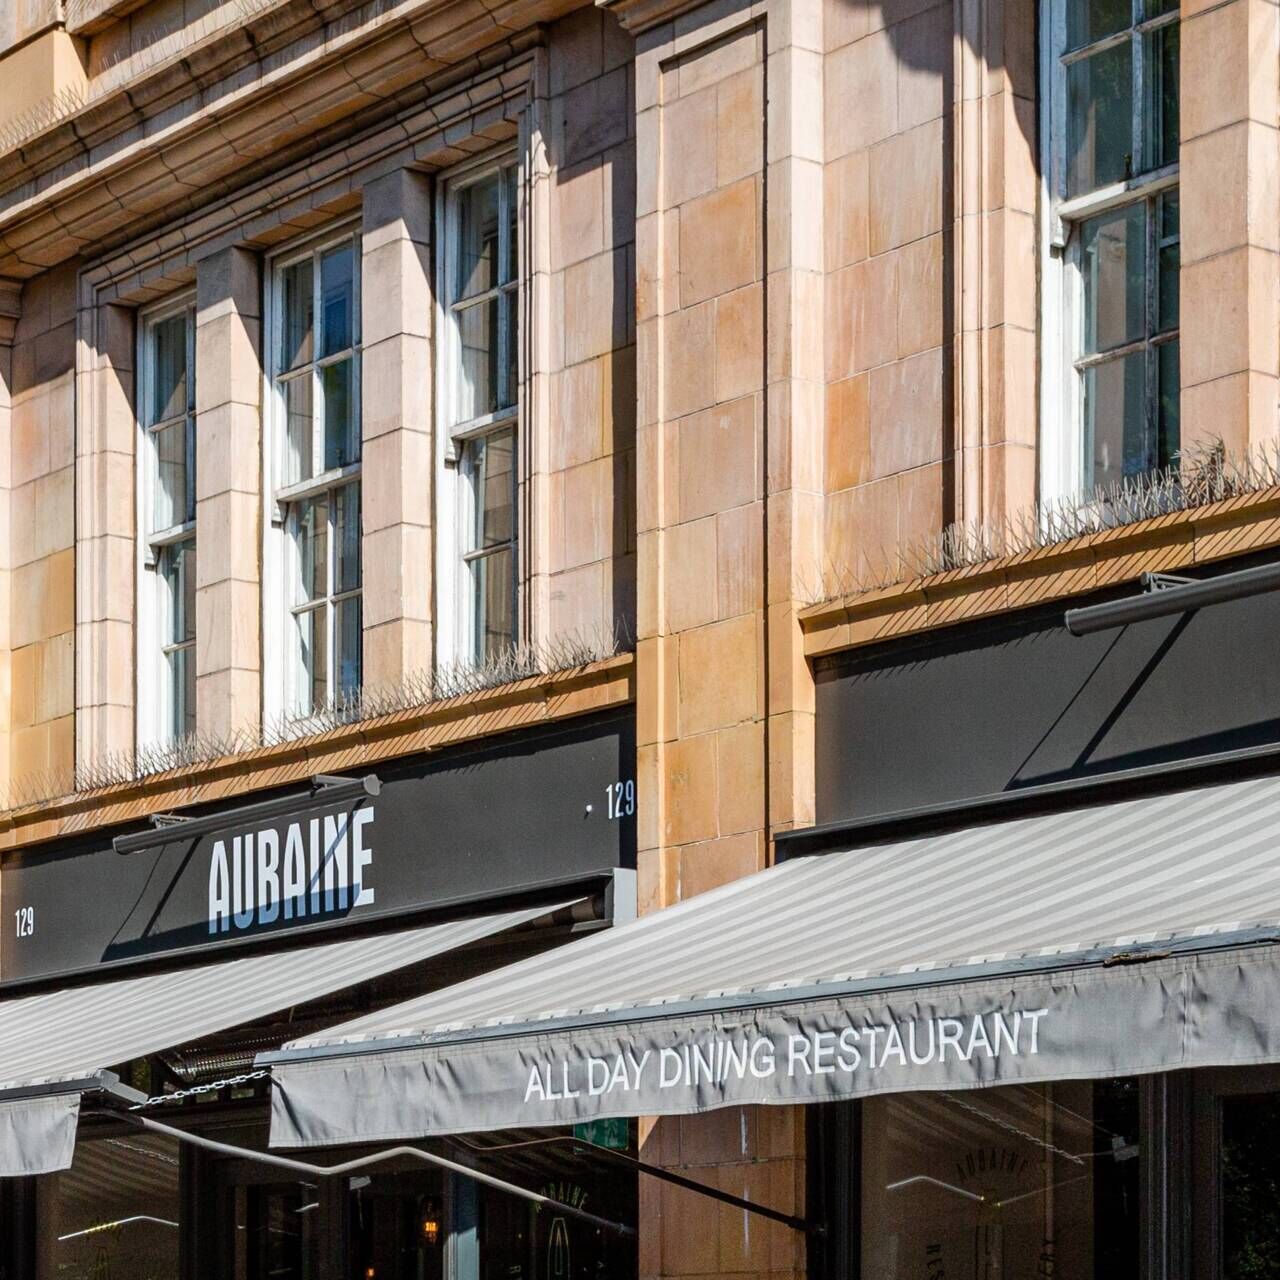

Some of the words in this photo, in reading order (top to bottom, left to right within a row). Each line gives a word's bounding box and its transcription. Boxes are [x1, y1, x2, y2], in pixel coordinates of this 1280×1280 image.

[606, 780, 634, 819] 129
[208, 806, 375, 934] AUBAINE
[15, 907, 35, 937] 129
[525, 1063, 580, 1102] ALL
[588, 1050, 649, 1096] DAY
[660, 1037, 776, 1088] DINING
[788, 1008, 1049, 1077] RESTAURANT
